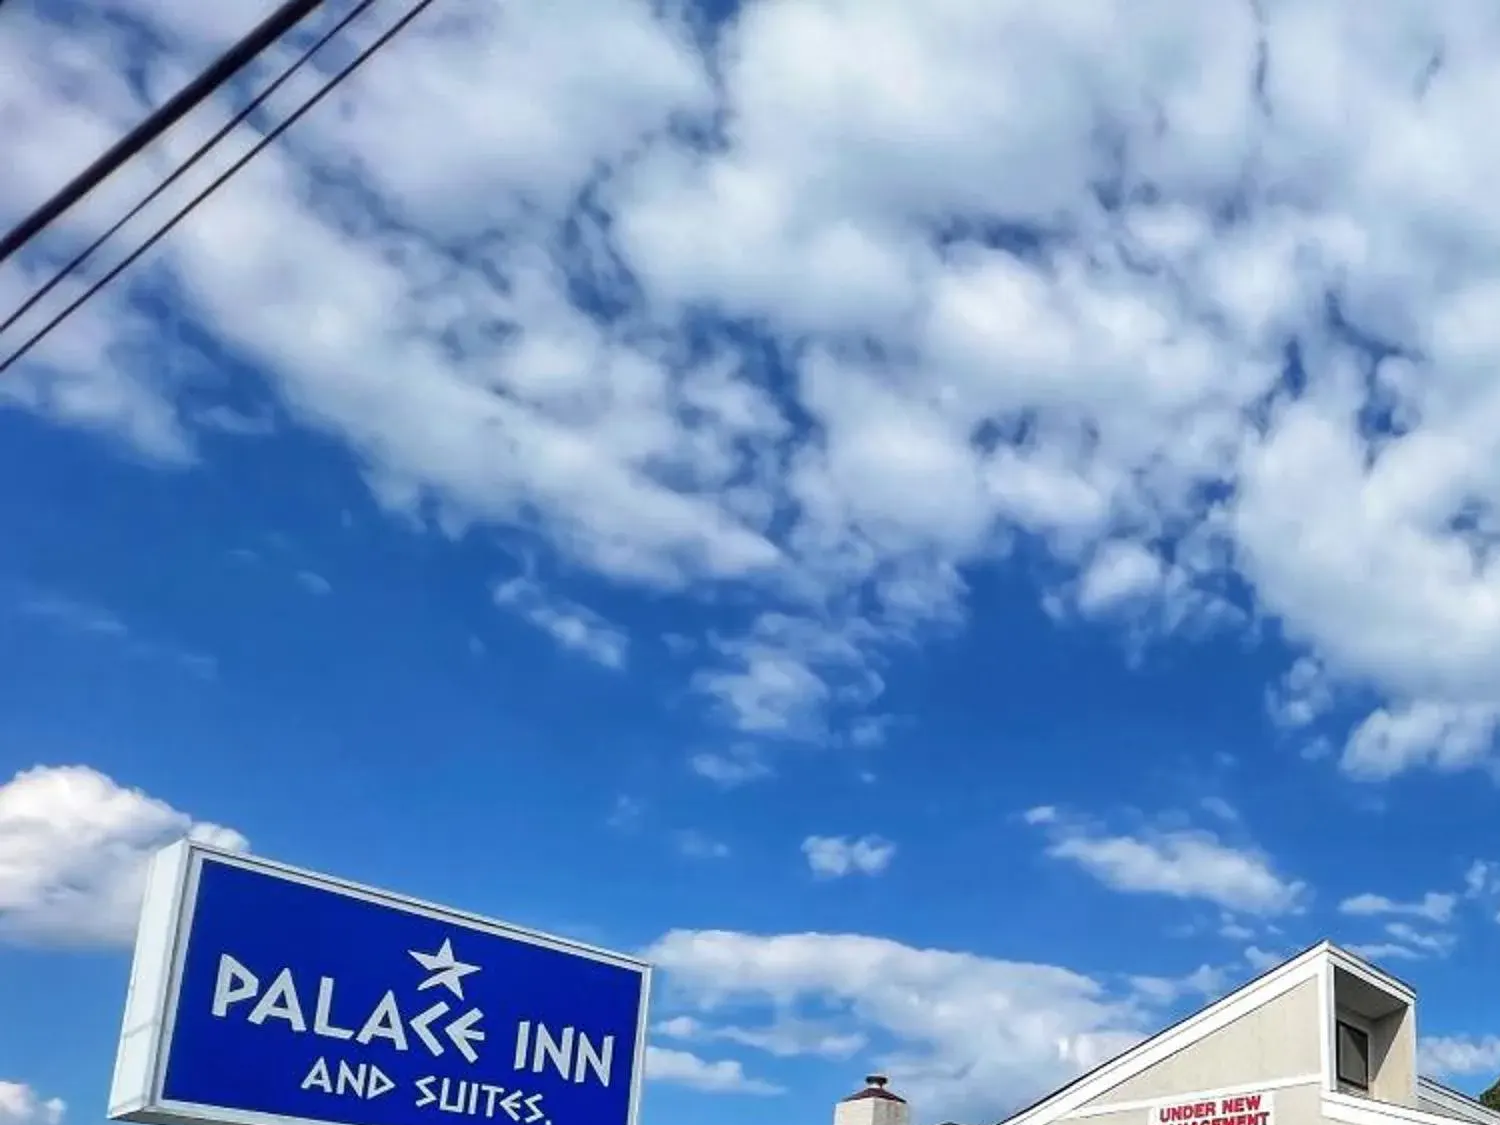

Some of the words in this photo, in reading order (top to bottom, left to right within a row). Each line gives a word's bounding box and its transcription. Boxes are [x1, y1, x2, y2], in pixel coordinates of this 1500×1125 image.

[211, 953, 486, 1063] PALACE
[514, 1020, 615, 1087] INN
[301, 1057, 396, 1100] AND
[1160, 1101, 1216, 1122] UNDER
[1222, 1094, 1262, 1114] NEW
